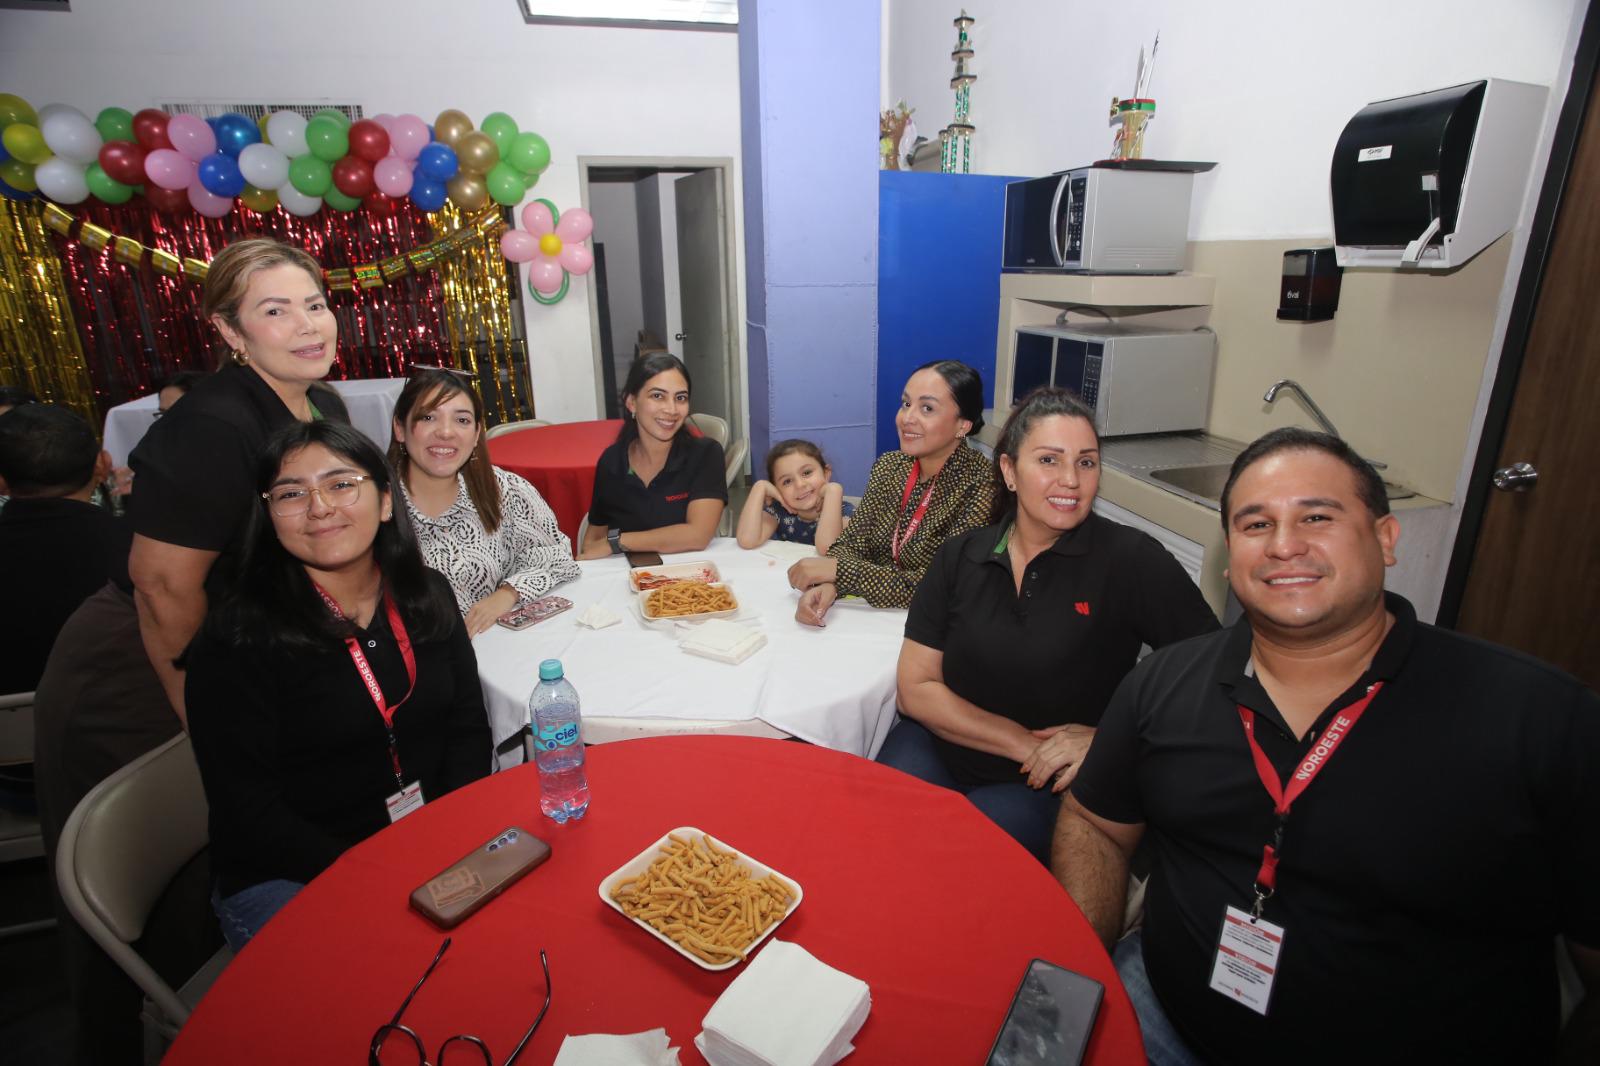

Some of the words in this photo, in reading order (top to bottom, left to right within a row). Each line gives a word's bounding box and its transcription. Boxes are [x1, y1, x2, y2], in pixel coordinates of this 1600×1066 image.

[354, 650, 381, 701] NOROESTE
[555, 724, 578, 741] ciel
[1296, 715, 1351, 781] NOROESTE
